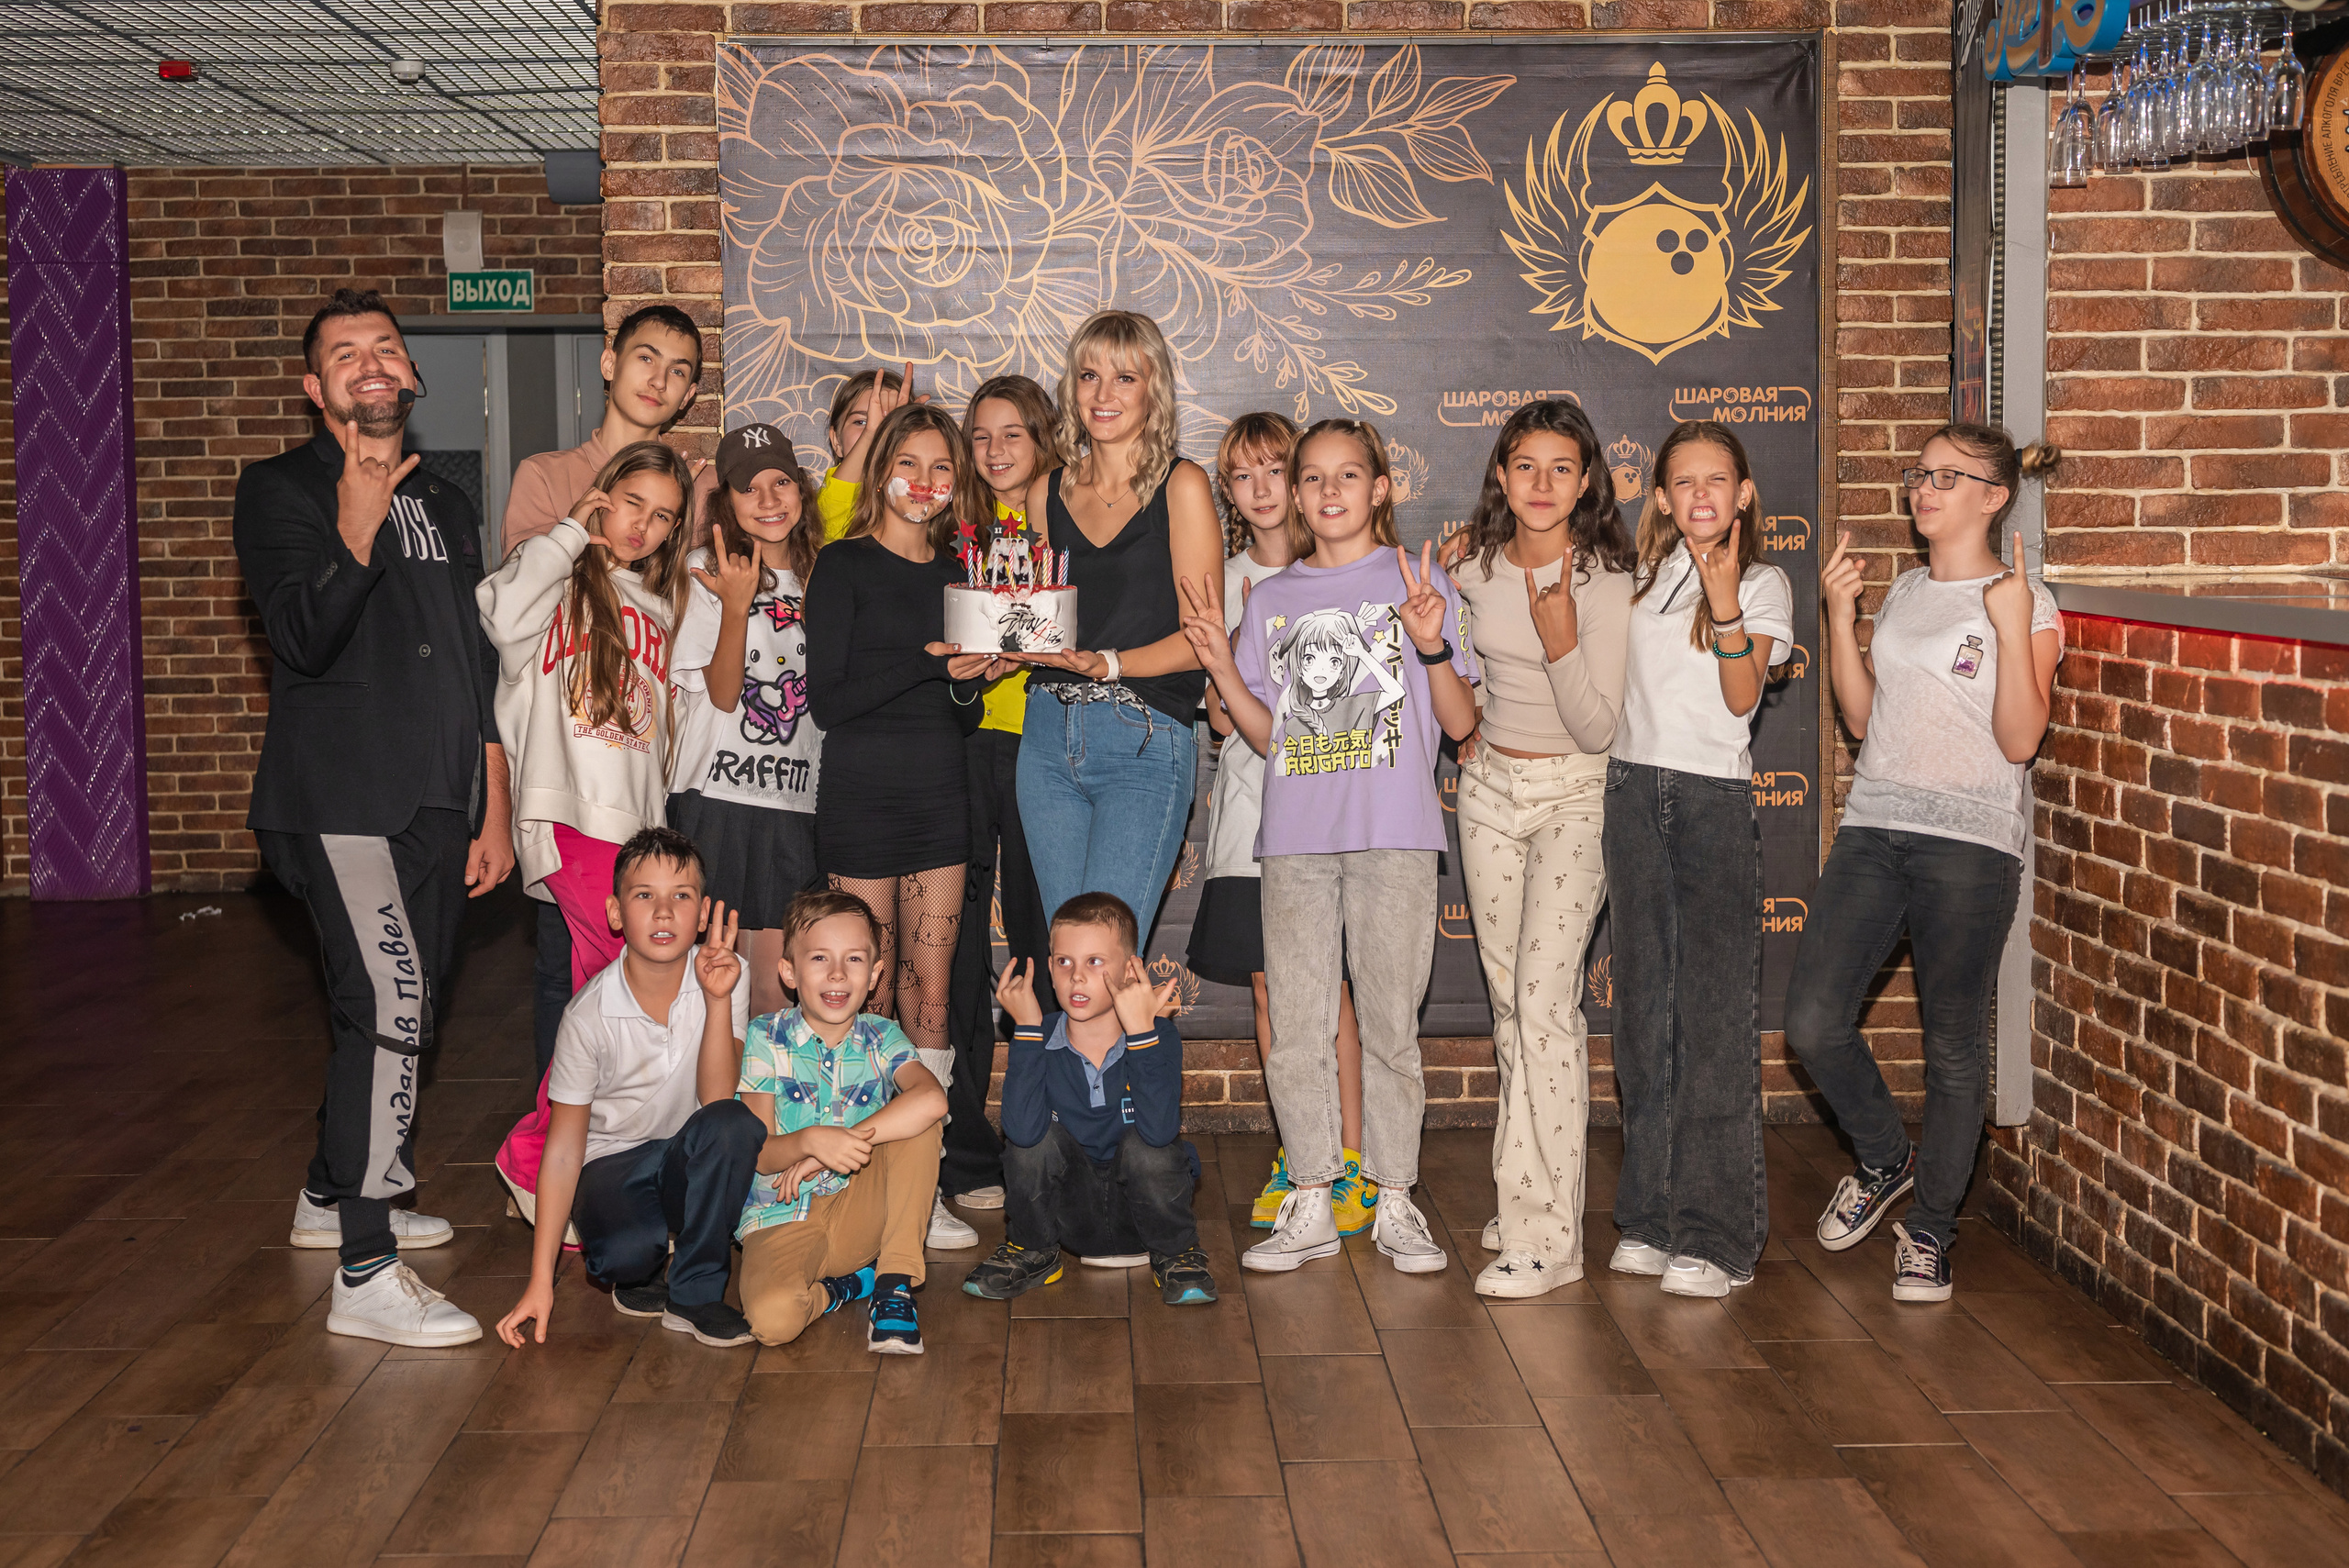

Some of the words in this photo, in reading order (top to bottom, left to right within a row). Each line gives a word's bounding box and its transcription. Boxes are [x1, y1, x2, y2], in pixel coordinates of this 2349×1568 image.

[2321, 86, 2340, 139] АЛКОГОЛЯ
[452, 278, 530, 306] ВЫХОД
[1443, 390, 1547, 407] ШАРОВАЯ
[1675, 386, 1778, 405] ШАРОВАЯ
[1712, 406, 1806, 423] МОЛНИЯ
[741, 427, 772, 450] NY
[1763, 534, 1806, 550] НИЯ
[577, 726, 594, 735] THE
[596, 728, 624, 742] GOLDEN
[626, 738, 646, 751] STATE
[1283, 729, 1373, 757] 今日も元気!
[707, 750, 810, 793] RAFFITI
[1284, 750, 1373, 776] ARIGATO
[1762, 916, 1803, 933] НИЯ
[377, 903, 421, 1000] Павел
